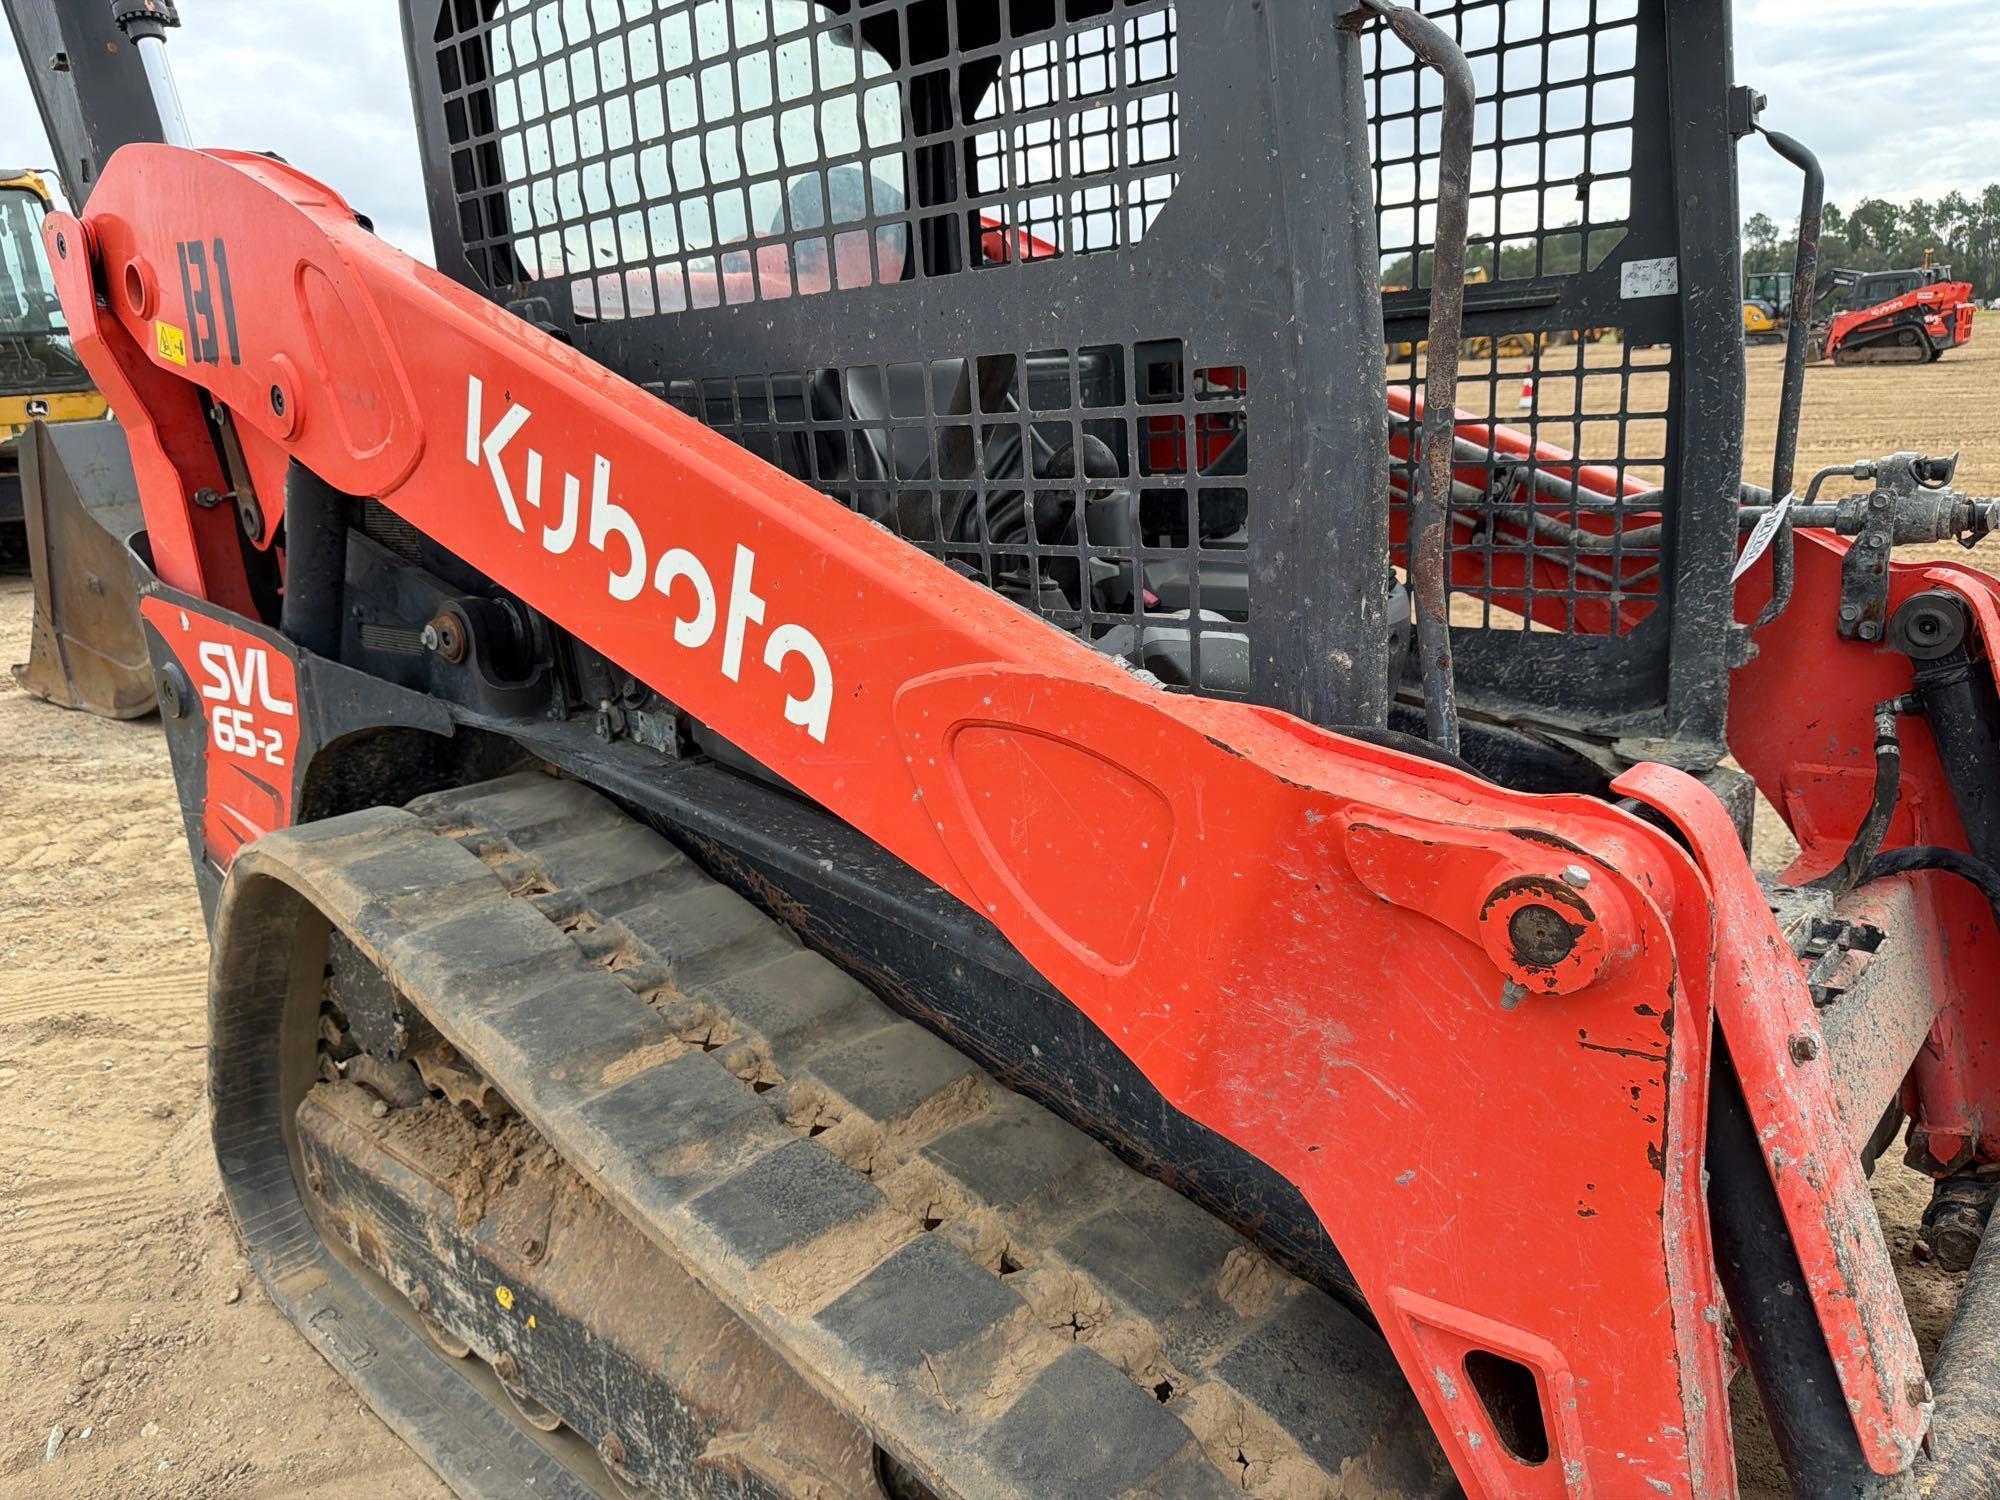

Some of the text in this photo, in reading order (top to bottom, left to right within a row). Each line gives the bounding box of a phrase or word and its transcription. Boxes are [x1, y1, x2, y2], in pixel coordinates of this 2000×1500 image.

[466, 373, 834, 745] Kubota
[198, 640, 294, 716] SVL
[212, 705, 285, 766] 65-2
